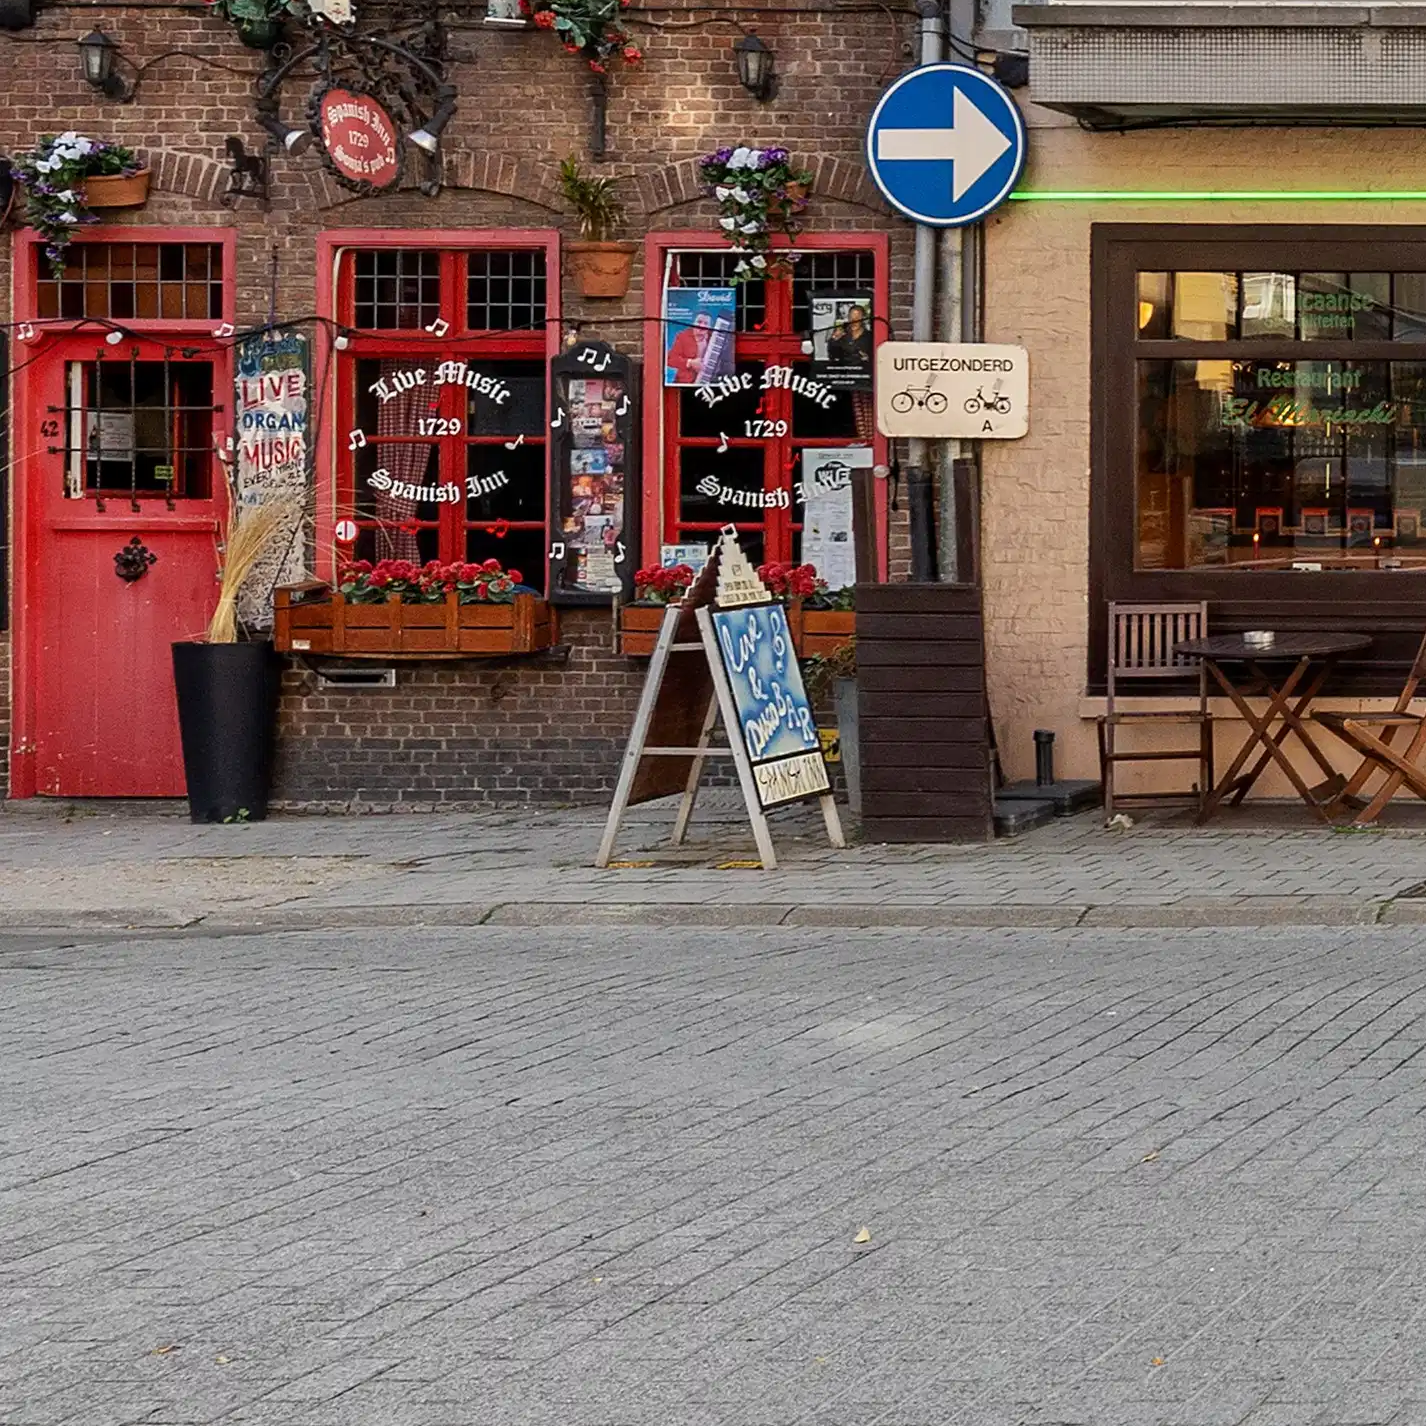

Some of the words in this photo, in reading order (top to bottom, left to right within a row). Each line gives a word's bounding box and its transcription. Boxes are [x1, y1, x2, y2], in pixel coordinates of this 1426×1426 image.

[327, 103, 371, 127] Spanish
[370, 111, 391, 146] Inn
[348, 130, 370, 148] 1729
[893, 358, 1014, 372] UITGEZONDERD
[1257, 367, 1362, 389] Restaurant
[242, 373, 302, 410] LIVE
[368, 367, 427, 405] Live
[433, 360, 511, 405] Music
[694, 372, 753, 409] Live
[758, 365, 838, 410] Music
[243, 410, 306, 431] ORGAN
[1222, 396, 1258, 426] El
[40, 420, 60, 437] 42
[417, 418, 461, 436] 1729
[744, 420, 788, 438] 1729
[981, 420, 993, 432] A
[242, 436, 302, 474] MUSIC
[366, 468, 461, 505] Spanish
[464, 470, 510, 499] Inn
[695, 475, 790, 510] Spanish
